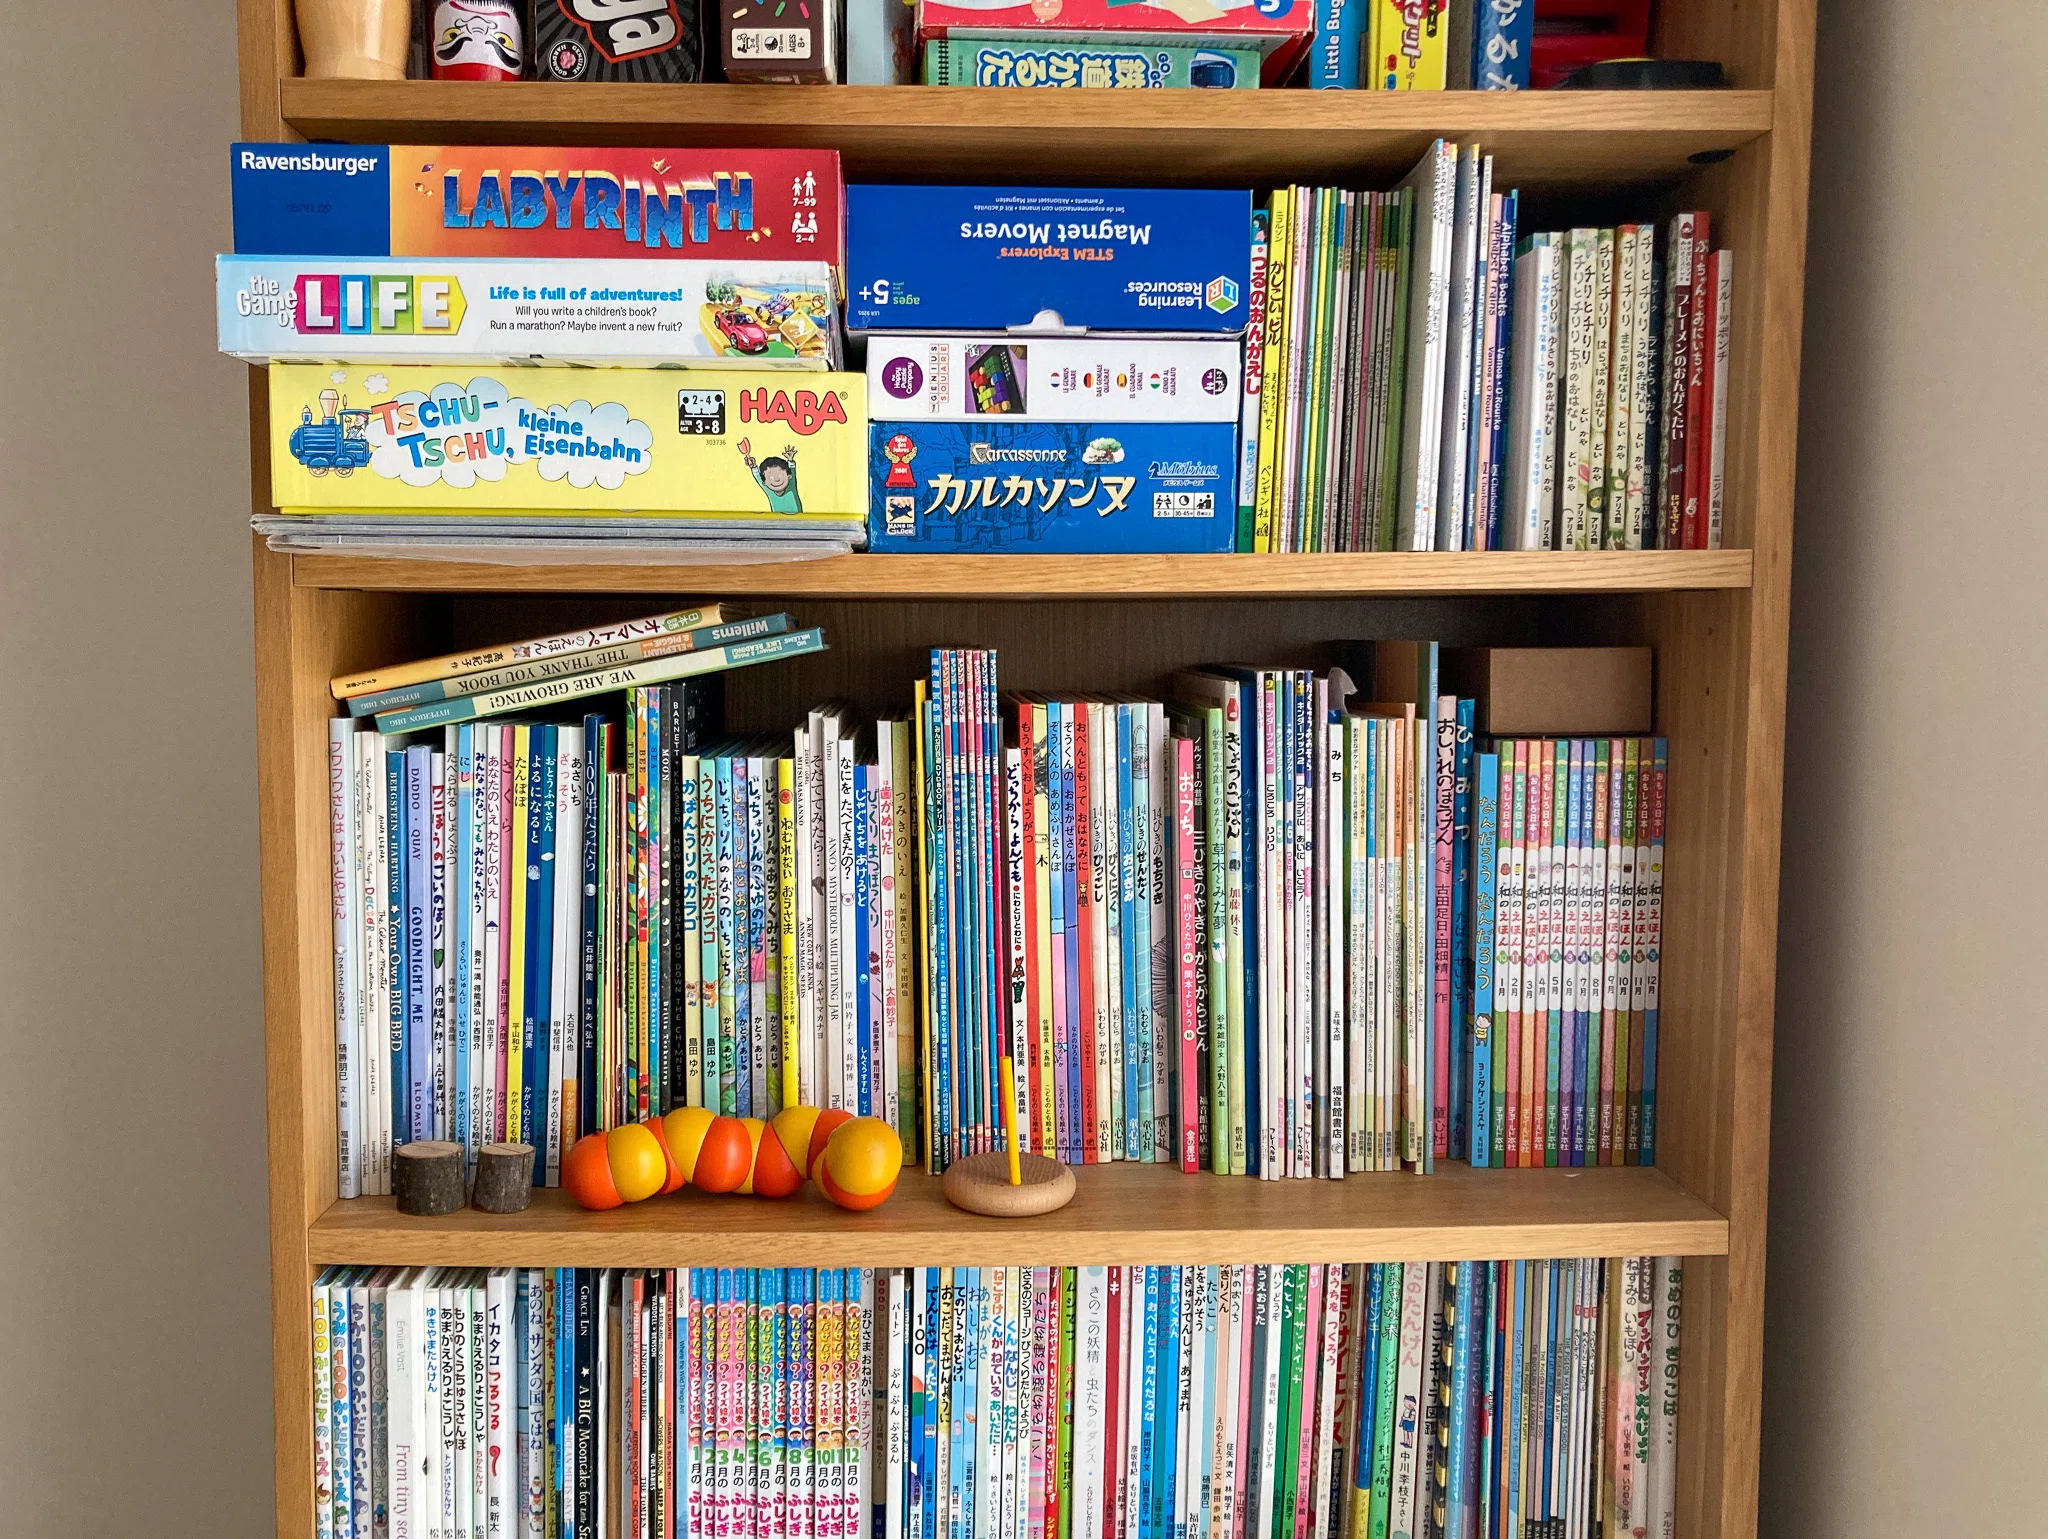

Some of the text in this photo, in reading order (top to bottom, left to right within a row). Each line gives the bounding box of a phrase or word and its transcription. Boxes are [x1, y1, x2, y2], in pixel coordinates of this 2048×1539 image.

[1325, 35, 1339, 79] Little
[241, 152, 378, 173] Ravensburger
[442, 168, 754, 250] LABYRINTH
[995, 196, 1026, 205] Magneten
[1018, 204, 1041, 212] imanes
[1038, 197, 1070, 205] Aktionsset
[1055, 204, 1105, 213] experimentación
[1106, 205, 1114, 213] de
[1115, 205, 1125, 213] Set
[960, 218, 1152, 245] Magnet Movers
[1000, 245, 1115, 261] STEM Explorers
[237, 287, 298, 317] Game
[250, 275, 279, 297] the
[304, 280, 450, 329] LIFE
[490, 287, 683, 302] Life is full of adventures!
[859, 279, 891, 305] 5+
[893, 294, 920, 306] ages
[1127, 281, 1203, 295] Resources
[1138, 293, 1203, 310] Learning
[1598, 244, 1613, 329] チリとチリリ
[1621, 239, 1636, 327] チリとチリリ
[278, 309, 297, 329] of
[490, 320, 507, 330] Run
[517, 320, 565, 331] marathon?
[567, 320, 598, 333] Maybe
[599, 321, 627, 331] invent
[636, 323, 656, 332] new
[657, 321, 683, 332] fruit?
[515, 306, 657, 318] Will you write a children's book?
[1246, 256, 1268, 394] つるのおんがえし
[1493, 222, 1512, 431] Alphabet Boats O'Rourke
[1582, 266, 1595, 364] チリとチリリ
[1690, 240, 1710, 387] ぶーちゃんとおにいちゃん
[1717, 278, 1732, 363] フルーツポンチ
[906, 361, 915, 395] Company
[930, 346, 938, 402] GENIUS
[940, 346, 948, 402] SQUARE
[1595, 340, 1608, 428] はらっぱのおはなし
[1618, 332, 1630, 403] まちのおはなし
[1645, 335, 1657, 425] ラチとらいおん
[1672, 293, 1690, 441] ブレーメンのおんがくたい
[371, 394, 499, 436] TSCHU-
[518, 408, 583, 436] kleine
[740, 386, 848, 436] HABA
[396, 427, 515, 469] TSCHU,
[525, 434, 642, 463] Eisenbahn
[971, 442, 1067, 465] Carcassonne
[924, 473, 1138, 518] カルカソンヌ
[1257, 465, 1271, 518] ペンギン社
[1488, 476, 1498, 529] Charlesbridge
[1576, 503, 1584, 531] アリス館
[712, 619, 768, 640] Willems
[458, 648, 629, 692] THE THANK YOU BOOK
[461, 651, 504, 669] 高野紀子
[489, 668, 636, 708] WE ARE GROWING!
[330, 741, 345, 833] フワフワさんは
[410, 768, 421, 809] DADDO
[446, 753, 457, 808] たべられる
[514, 756, 527, 808] たんぽぽ
[558, 753, 570, 813] ざっそう
[570, 757, 583, 807] あさいち
[661, 748, 670, 783] MOON
[1021, 721, 1034, 844] もうすぐおしょうがつ
[1226, 731, 1242, 839] きょうのごはん
[1330, 748, 1342, 783] みち
[1436, 717, 1456, 847] おしいれのぼうけん
[529, 754, 542, 844] よるになると
[543, 755, 556, 832] おとうふやさん
[585, 750, 598, 872] 100年たったら
[880, 785, 894, 856] 歯がぬけた
[1179, 771, 1194, 836] おうち
[411, 829, 422, 861] QUAY
[682, 778, 700, 932] かばんうりのガラゴ
[700, 772, 718, 944] うちにかえったガラゴ
[895, 790, 908, 877] つみきのいえ
[1093, 806, 1104, 903] 14ひきのひっこし
[1136, 805, 1148, 901] 14ひきのせんたく
[1151, 807, 1164, 905] 14ひきのもちつき
[333, 841, 347, 920] けいとやさん
[1035, 855, 1048, 867] 木
[389, 771, 403, 1052] BERGSTEIN HARTUNG Your Own BIG BED
[884, 908, 895, 969] 中川ひろたか
[412, 1003, 424, 1024] ME
[1194, 950, 1209, 1053] がらがらどん
[1332, 1011, 1342, 1042] 五味太郎
[511, 1022, 520, 1054] 平山和子
[565, 1013, 575, 1052] 大石可久也
[860, 1047, 868, 1094] しんぐうすすむ
[1476, 1062, 1485, 1131] ヨシタケシンスケ
[1332, 1086, 1343, 1139] 福音館書店
[1494, 1106, 1504, 1151] チャイルド本社
[926, 1286, 939, 1350] でんしゃは
[978, 1286, 991, 1360] あまがさ
[1272, 1271, 1283, 1322] パンどうぞ
[426, 1307, 438, 1393] ゆきやまたんけん
[940, 1284, 954, 1423] おこだでませんように
[1292, 1321, 1305, 1385] サンドイッチ
[1623, 1312, 1638, 1363] いもほり
[1635, 1309, 1652, 1393] アンパンマン
[313, 1298, 330, 1477] 100かいだてのいえ
[441, 1308, 455, 1450] あまがえるりょこうしゃ
[454, 1307, 467, 1451] もりのくうちゅうさんぽ
[488, 1303, 501, 1432] イカタコつるつる
[1018, 1340, 1031, 1439] びっくりたんじょうび
[1425, 1312, 1442, 1436] こころキャラ図鑑
[332, 1300, 350, 1502] うみの100かいだてのいえ
[351, 1302, 369, 1492] ちか100かいだてのいえ
[578, 1285, 591, 1507] GRACE LIN BIG Mooncake for
[396, 1444, 411, 1515] From tiny
[1398, 1450, 1411, 1508] 中川李枝子
[788, 1492, 802, 1537] ふしぎ
